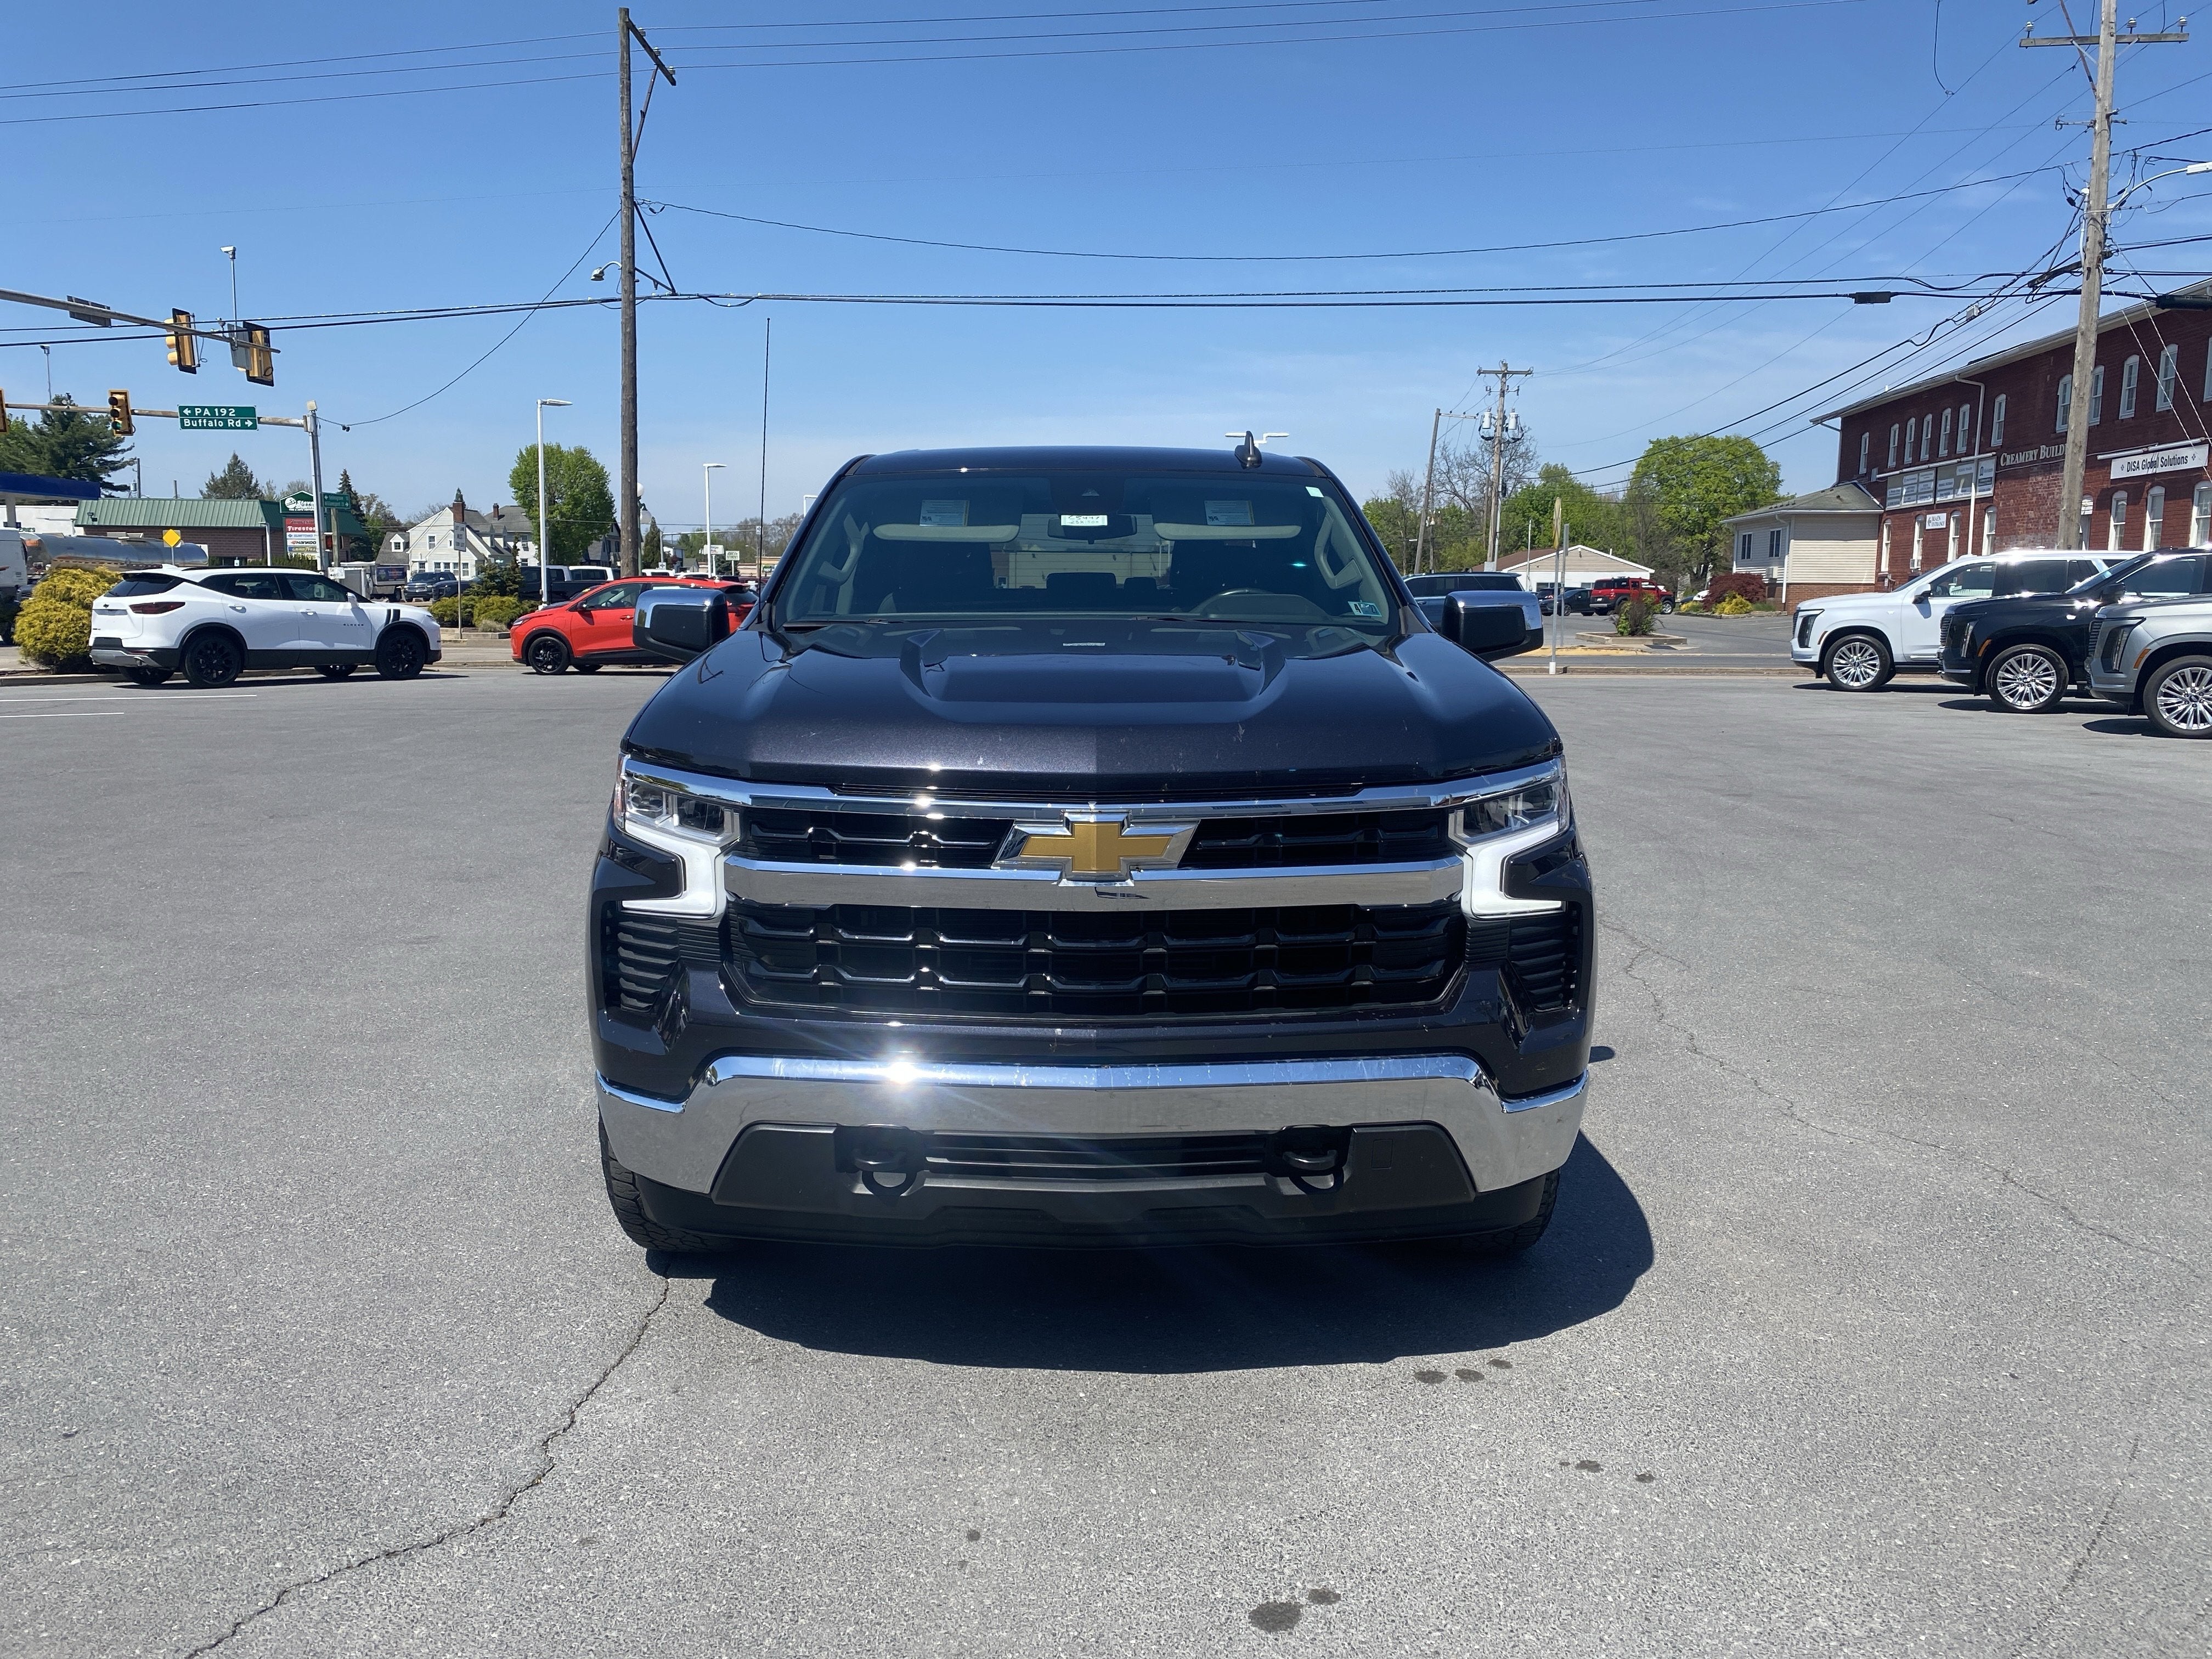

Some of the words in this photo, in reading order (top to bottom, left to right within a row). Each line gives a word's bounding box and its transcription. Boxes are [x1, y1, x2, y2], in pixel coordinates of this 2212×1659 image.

[195, 408, 211, 416] PA
[215, 408, 235, 416] 192
[184, 419, 223, 427] Buffalo
[228, 419, 241, 427] Rd
[2000, 449, 2039, 466] CREAMERY
[2126, 460, 2140, 472] DISA
[2141, 456, 2159, 470] Global
[2160, 454, 2188, 467] Solutions
